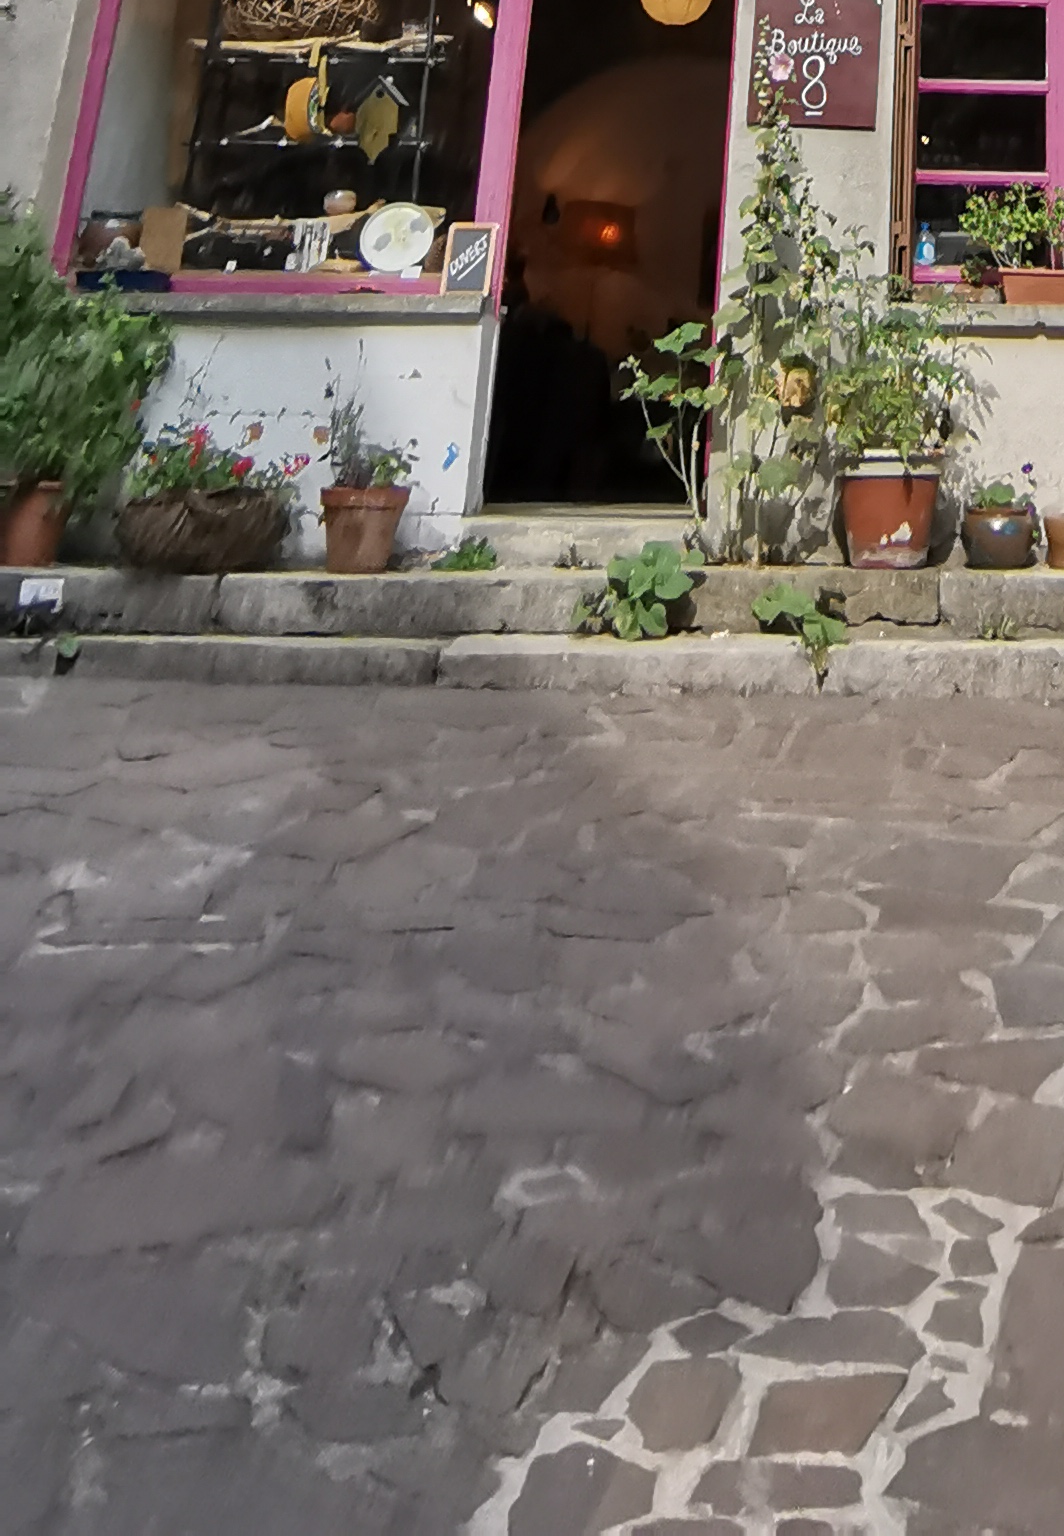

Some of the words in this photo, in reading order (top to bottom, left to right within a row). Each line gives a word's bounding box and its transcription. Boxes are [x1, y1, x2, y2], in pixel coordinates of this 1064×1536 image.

[766, 28, 862, 65] Boutique
[801, 55, 827, 110] 8
[449, 233, 488, 276] OUVERT
